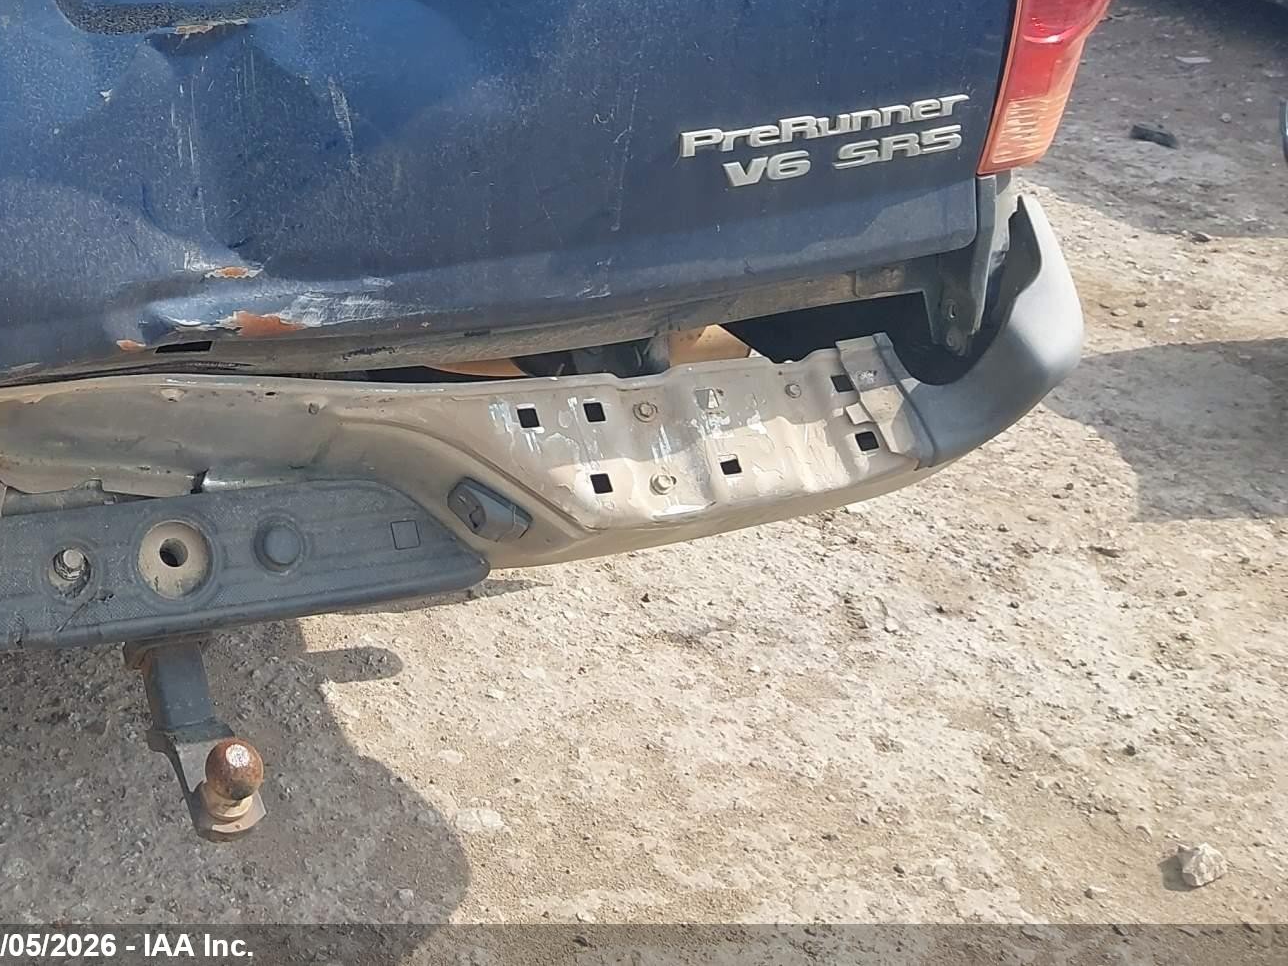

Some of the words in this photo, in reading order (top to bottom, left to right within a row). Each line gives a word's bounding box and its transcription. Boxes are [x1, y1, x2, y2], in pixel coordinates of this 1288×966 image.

[680, 93, 970, 158] PreRunner
[722, 149, 811, 187] V6
[832, 125, 962, 170] SR5
